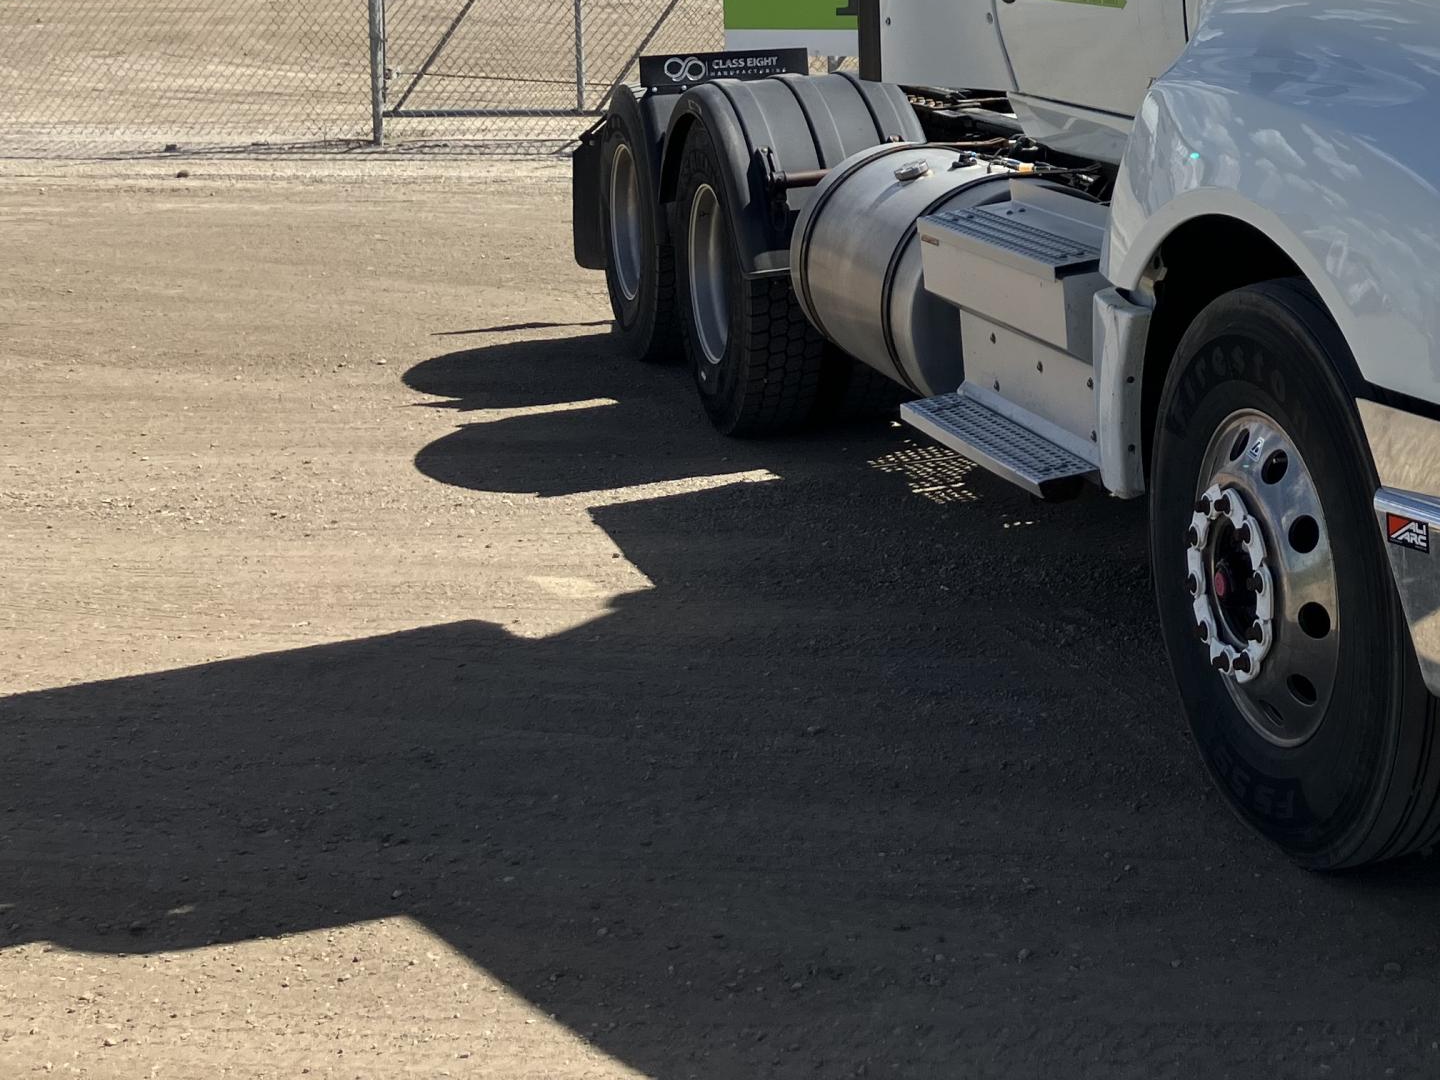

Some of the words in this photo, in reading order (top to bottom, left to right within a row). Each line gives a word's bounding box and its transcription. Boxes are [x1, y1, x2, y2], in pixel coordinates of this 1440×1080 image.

[712, 58, 745, 69] CLASS
[746, 56, 778, 68] EIGHT
[1397, 531, 1427, 547] ARC
